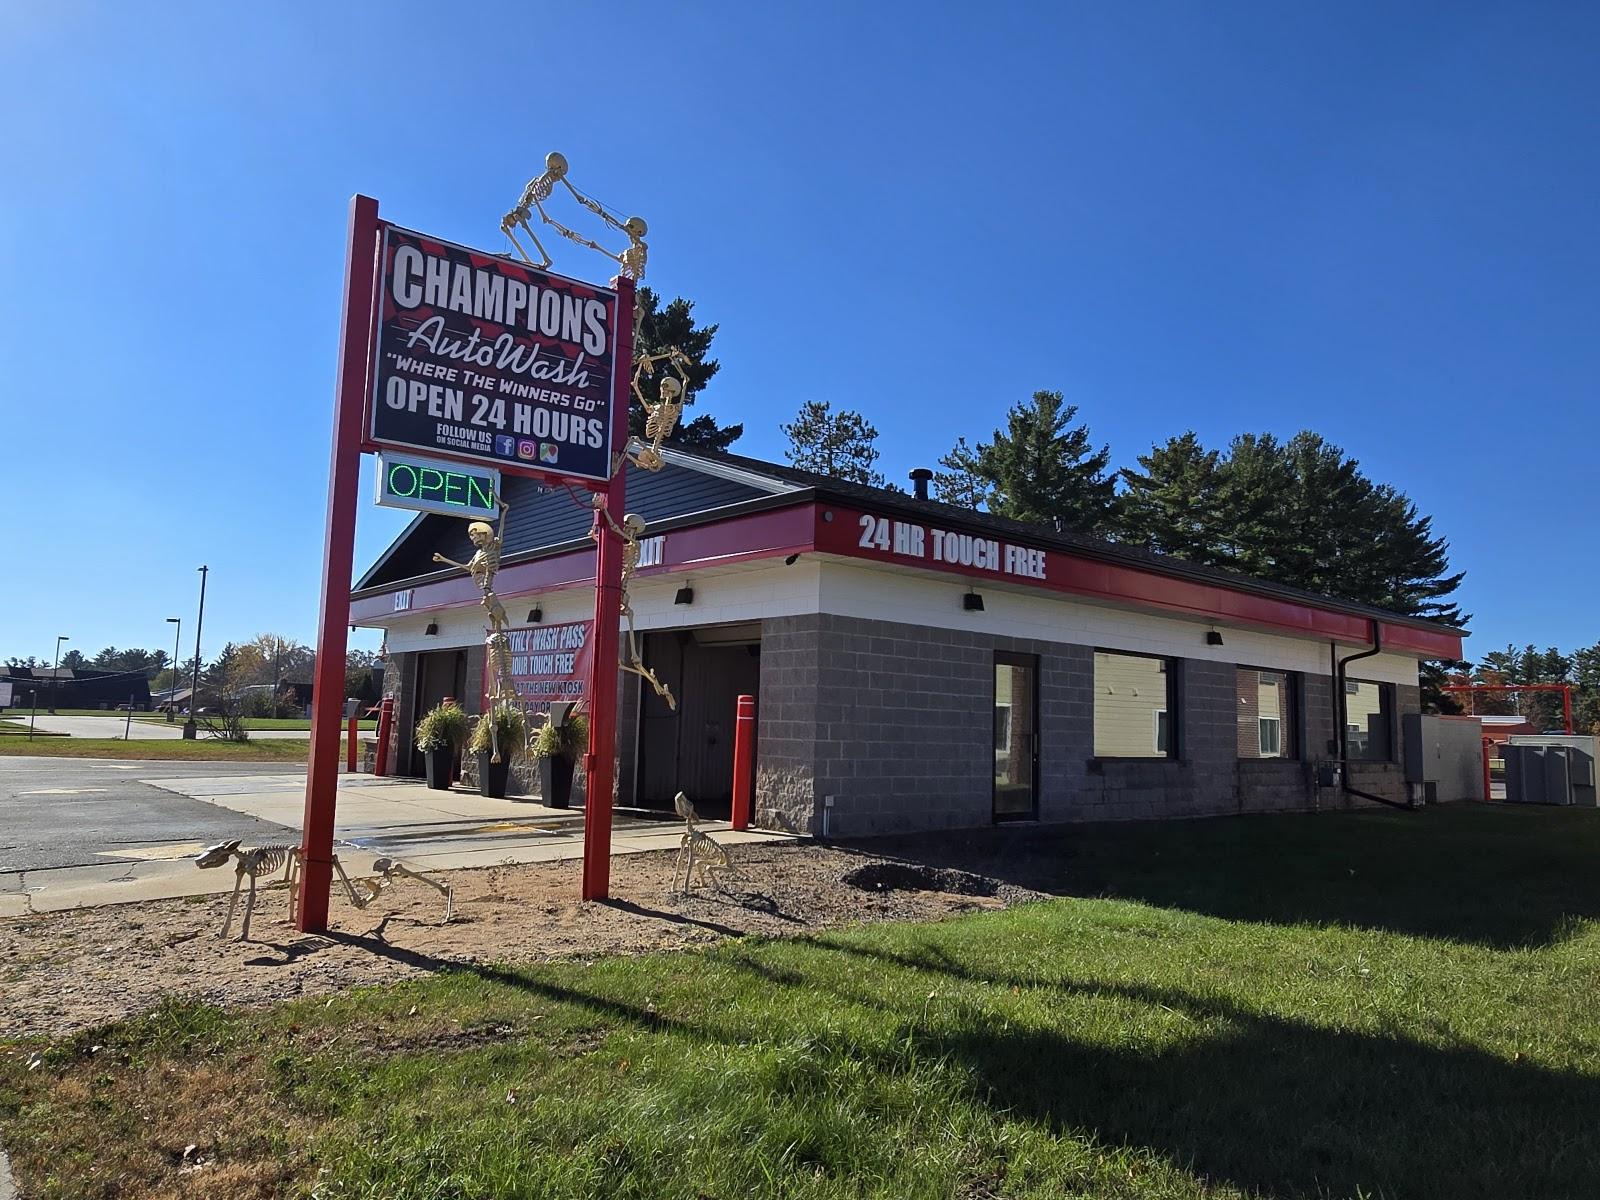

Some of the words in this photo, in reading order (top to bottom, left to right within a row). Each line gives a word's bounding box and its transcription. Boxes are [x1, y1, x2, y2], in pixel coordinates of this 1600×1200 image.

[463, 370, 496, 390] THE
[499, 379, 570, 407] WINNERS
[386, 376, 463, 421] OPEN
[471, 394, 507, 430] 24
[513, 402, 603, 449] HOURS
[437, 423, 477, 441] FOLLOW
[479, 431, 492, 444] US
[447, 437, 470, 448] SOCIAL
[471, 441, 491, 452] MEDIA
[390, 465, 493, 511] OPEN
[635, 535, 666, 568] XIT
[859, 514, 891, 551] 24
[893, 521, 925, 557] HR
[931, 529, 999, 571] TOUCH
[1004, 544, 1047, 580] FREE
[532, 627, 560, 651] WASH
[560, 624, 585, 649] PASS
[530, 654, 553, 675] TOUCH
[555, 653, 575, 674] FREE
[526, 681, 538, 694] THE
[539, 681, 557, 694] NEW
[557, 680, 583, 694] KIOSK
